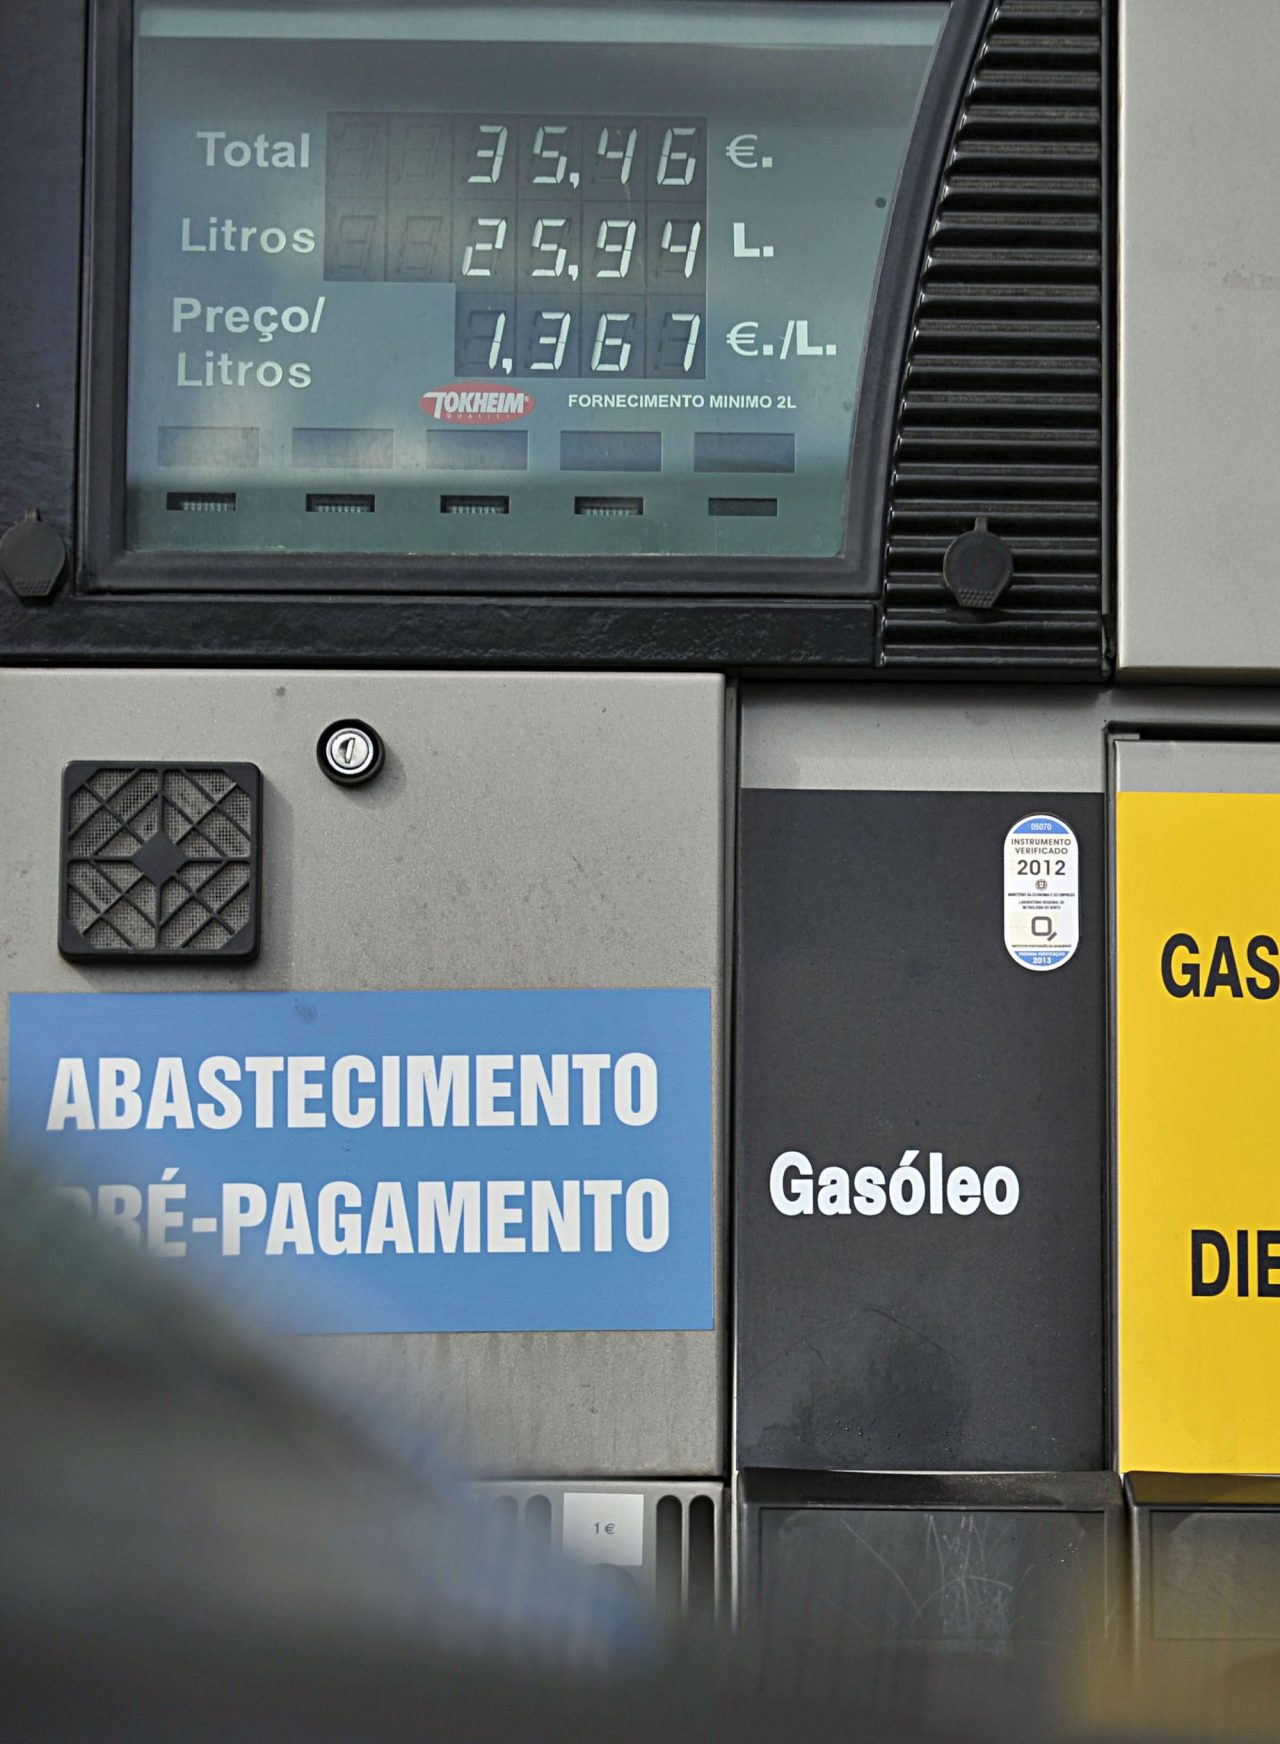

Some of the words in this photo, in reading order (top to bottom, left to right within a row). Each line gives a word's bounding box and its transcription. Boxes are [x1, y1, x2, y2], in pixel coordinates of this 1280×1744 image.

[197, 131, 310, 168] Total
[467, 125, 696, 189] 35,46
[181, 217, 316, 253] Litros
[462, 218, 701, 281] 25,94
[733, 222, 774, 258] L.
[172, 296, 326, 342] Preço/
[488, 312, 701, 375] 1,367
[177, 351, 312, 388] Litros
[423, 391, 525, 419] TOKHEIM
[568, 394, 702, 408] FORNECIMENTO
[710, 395, 772, 409] MINIMO
[776, 396, 797, 409] 2L
[1011, 838, 1072, 846] INSTRUMENTO
[1017, 859, 1066, 875] 2012
[46, 1052, 658, 1131] ABASTECIMENTO
[769, 1150, 1020, 1216] Gasóleo
[594, 1522, 600, 1535] 1
[604, 1523, 615, 1535] €
